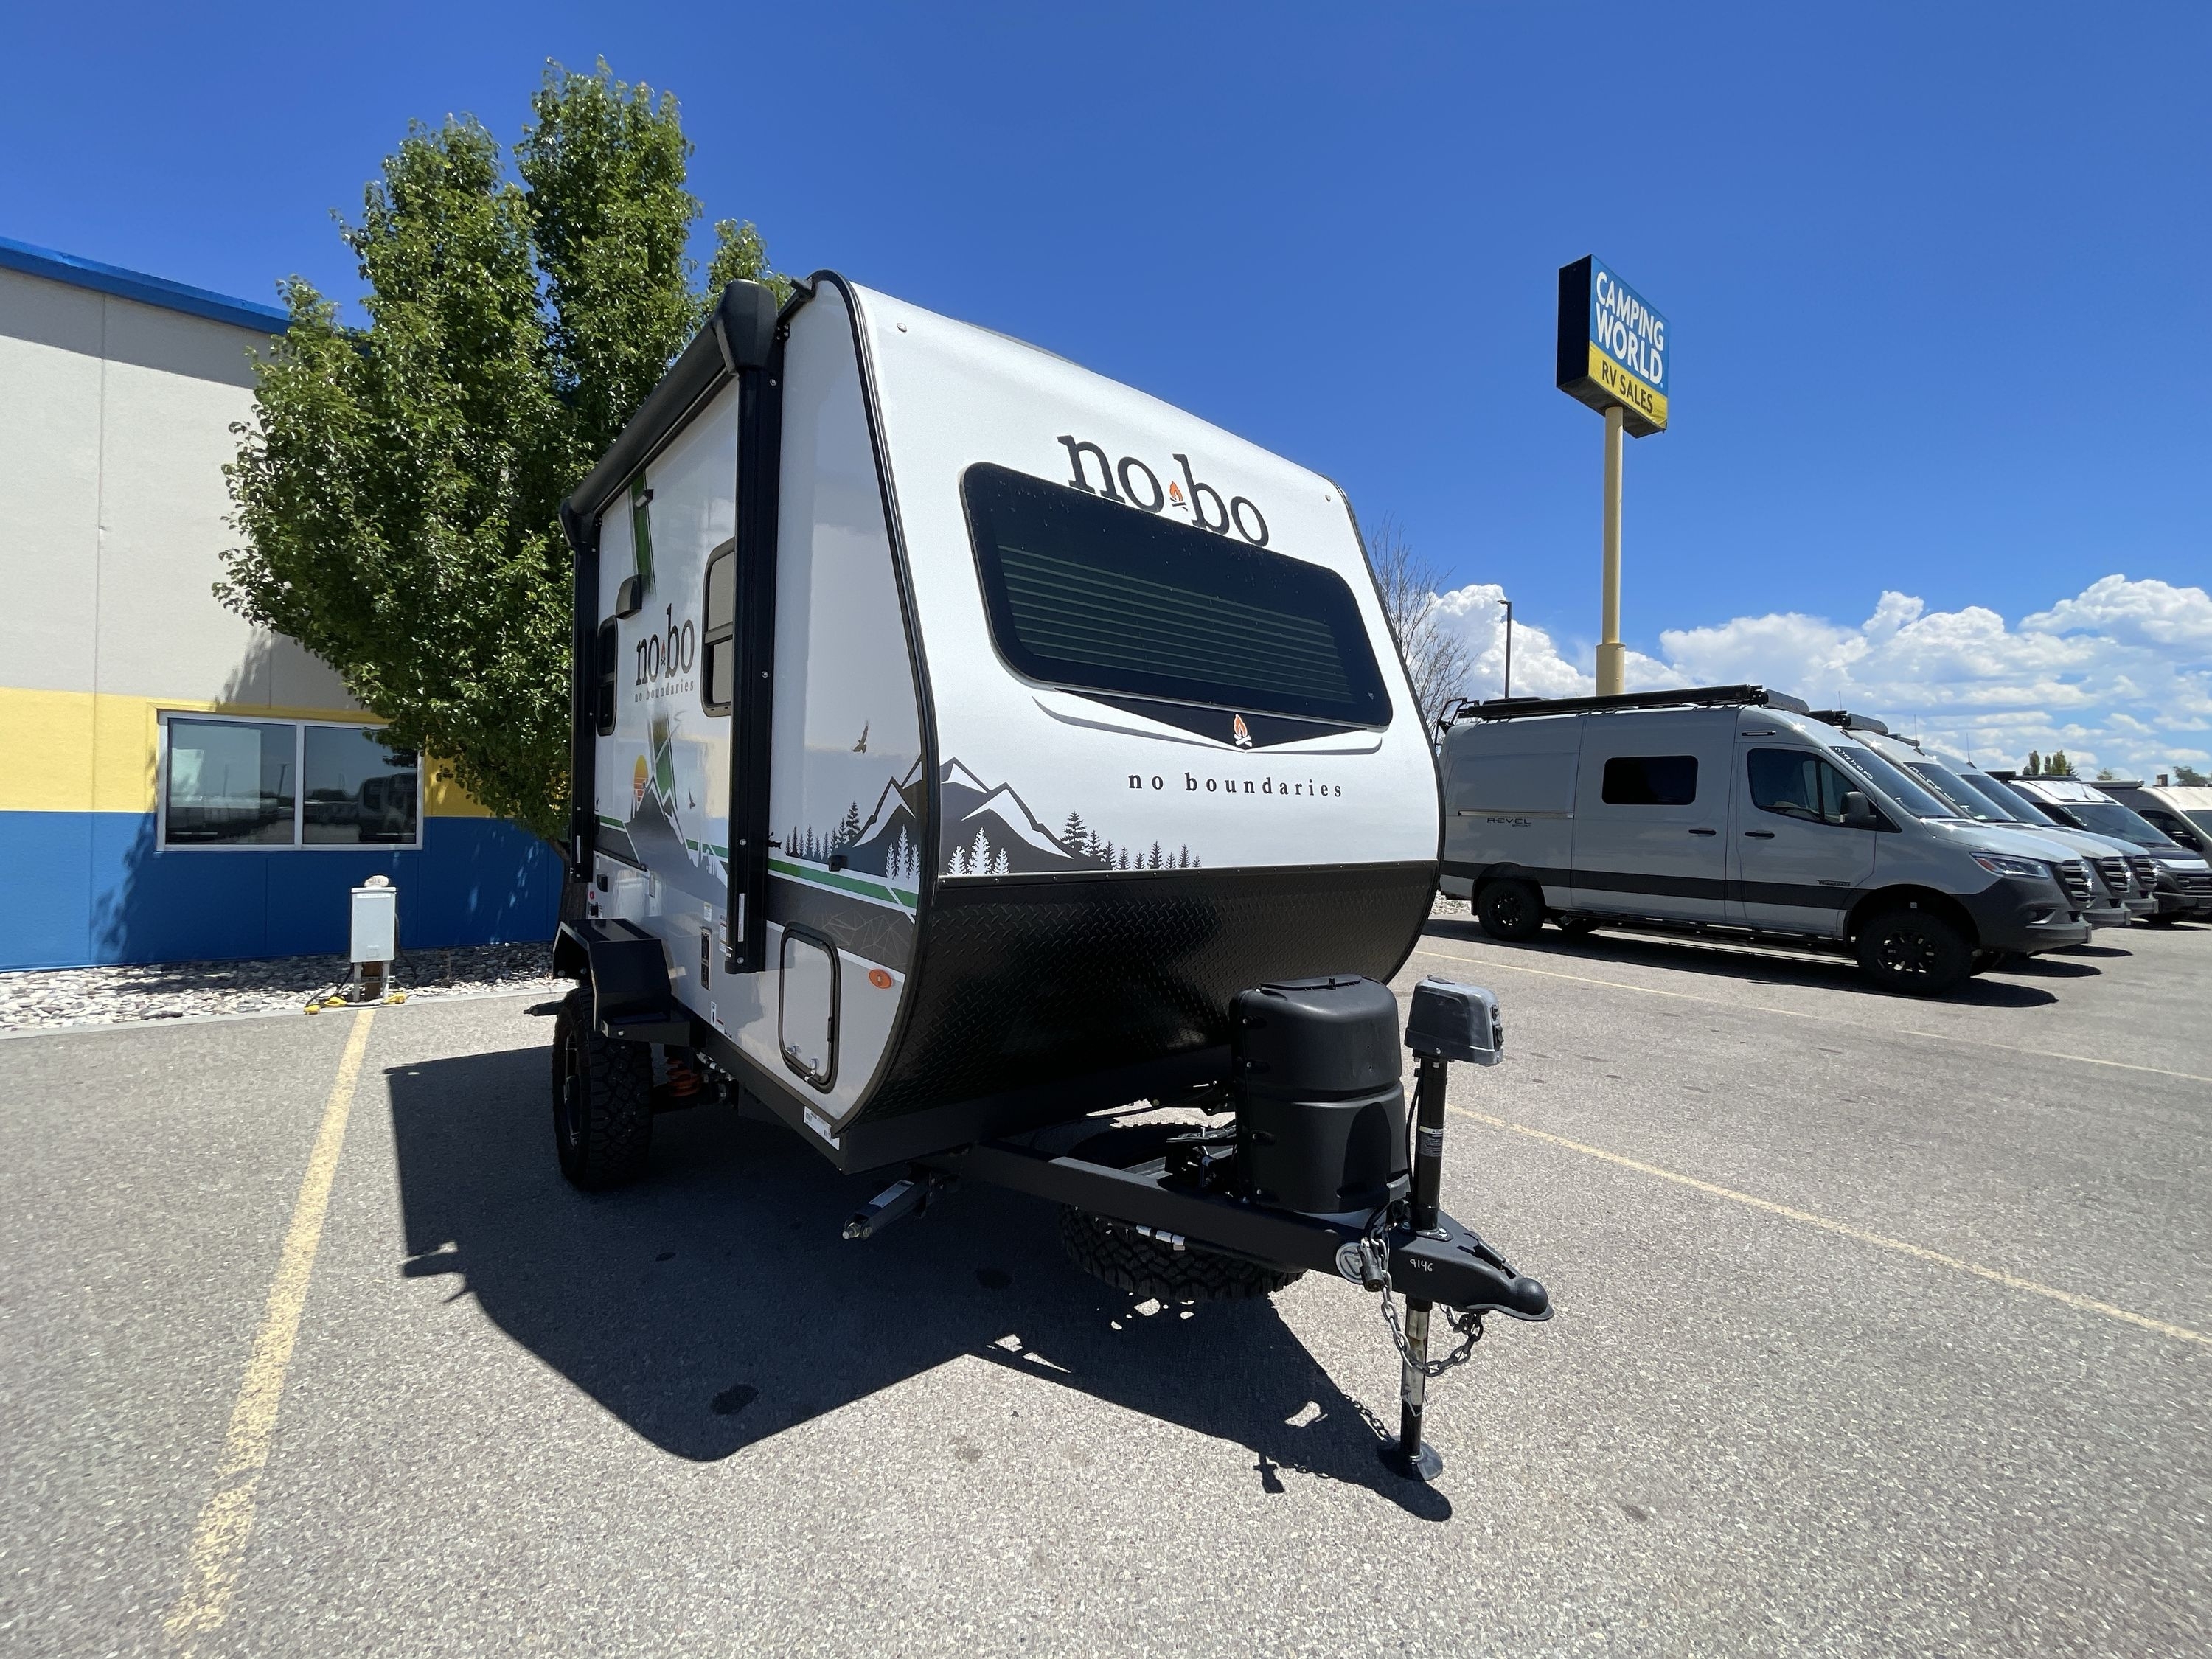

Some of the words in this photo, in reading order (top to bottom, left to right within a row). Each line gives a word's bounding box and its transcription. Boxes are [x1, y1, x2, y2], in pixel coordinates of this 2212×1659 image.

[1596, 271, 1663, 352] CAMPING
[1596, 302, 1663, 385] WORLD
[1601, 360, 1617, 388] RV
[1620, 375, 1653, 414] SALES
[634, 692, 642, 703] no
[646, 680, 694, 700] boundaries
[1128, 772, 1164, 791] no
[1185, 772, 1342, 798] boundaries
[1409, 1259, 1433, 1272] 9146
